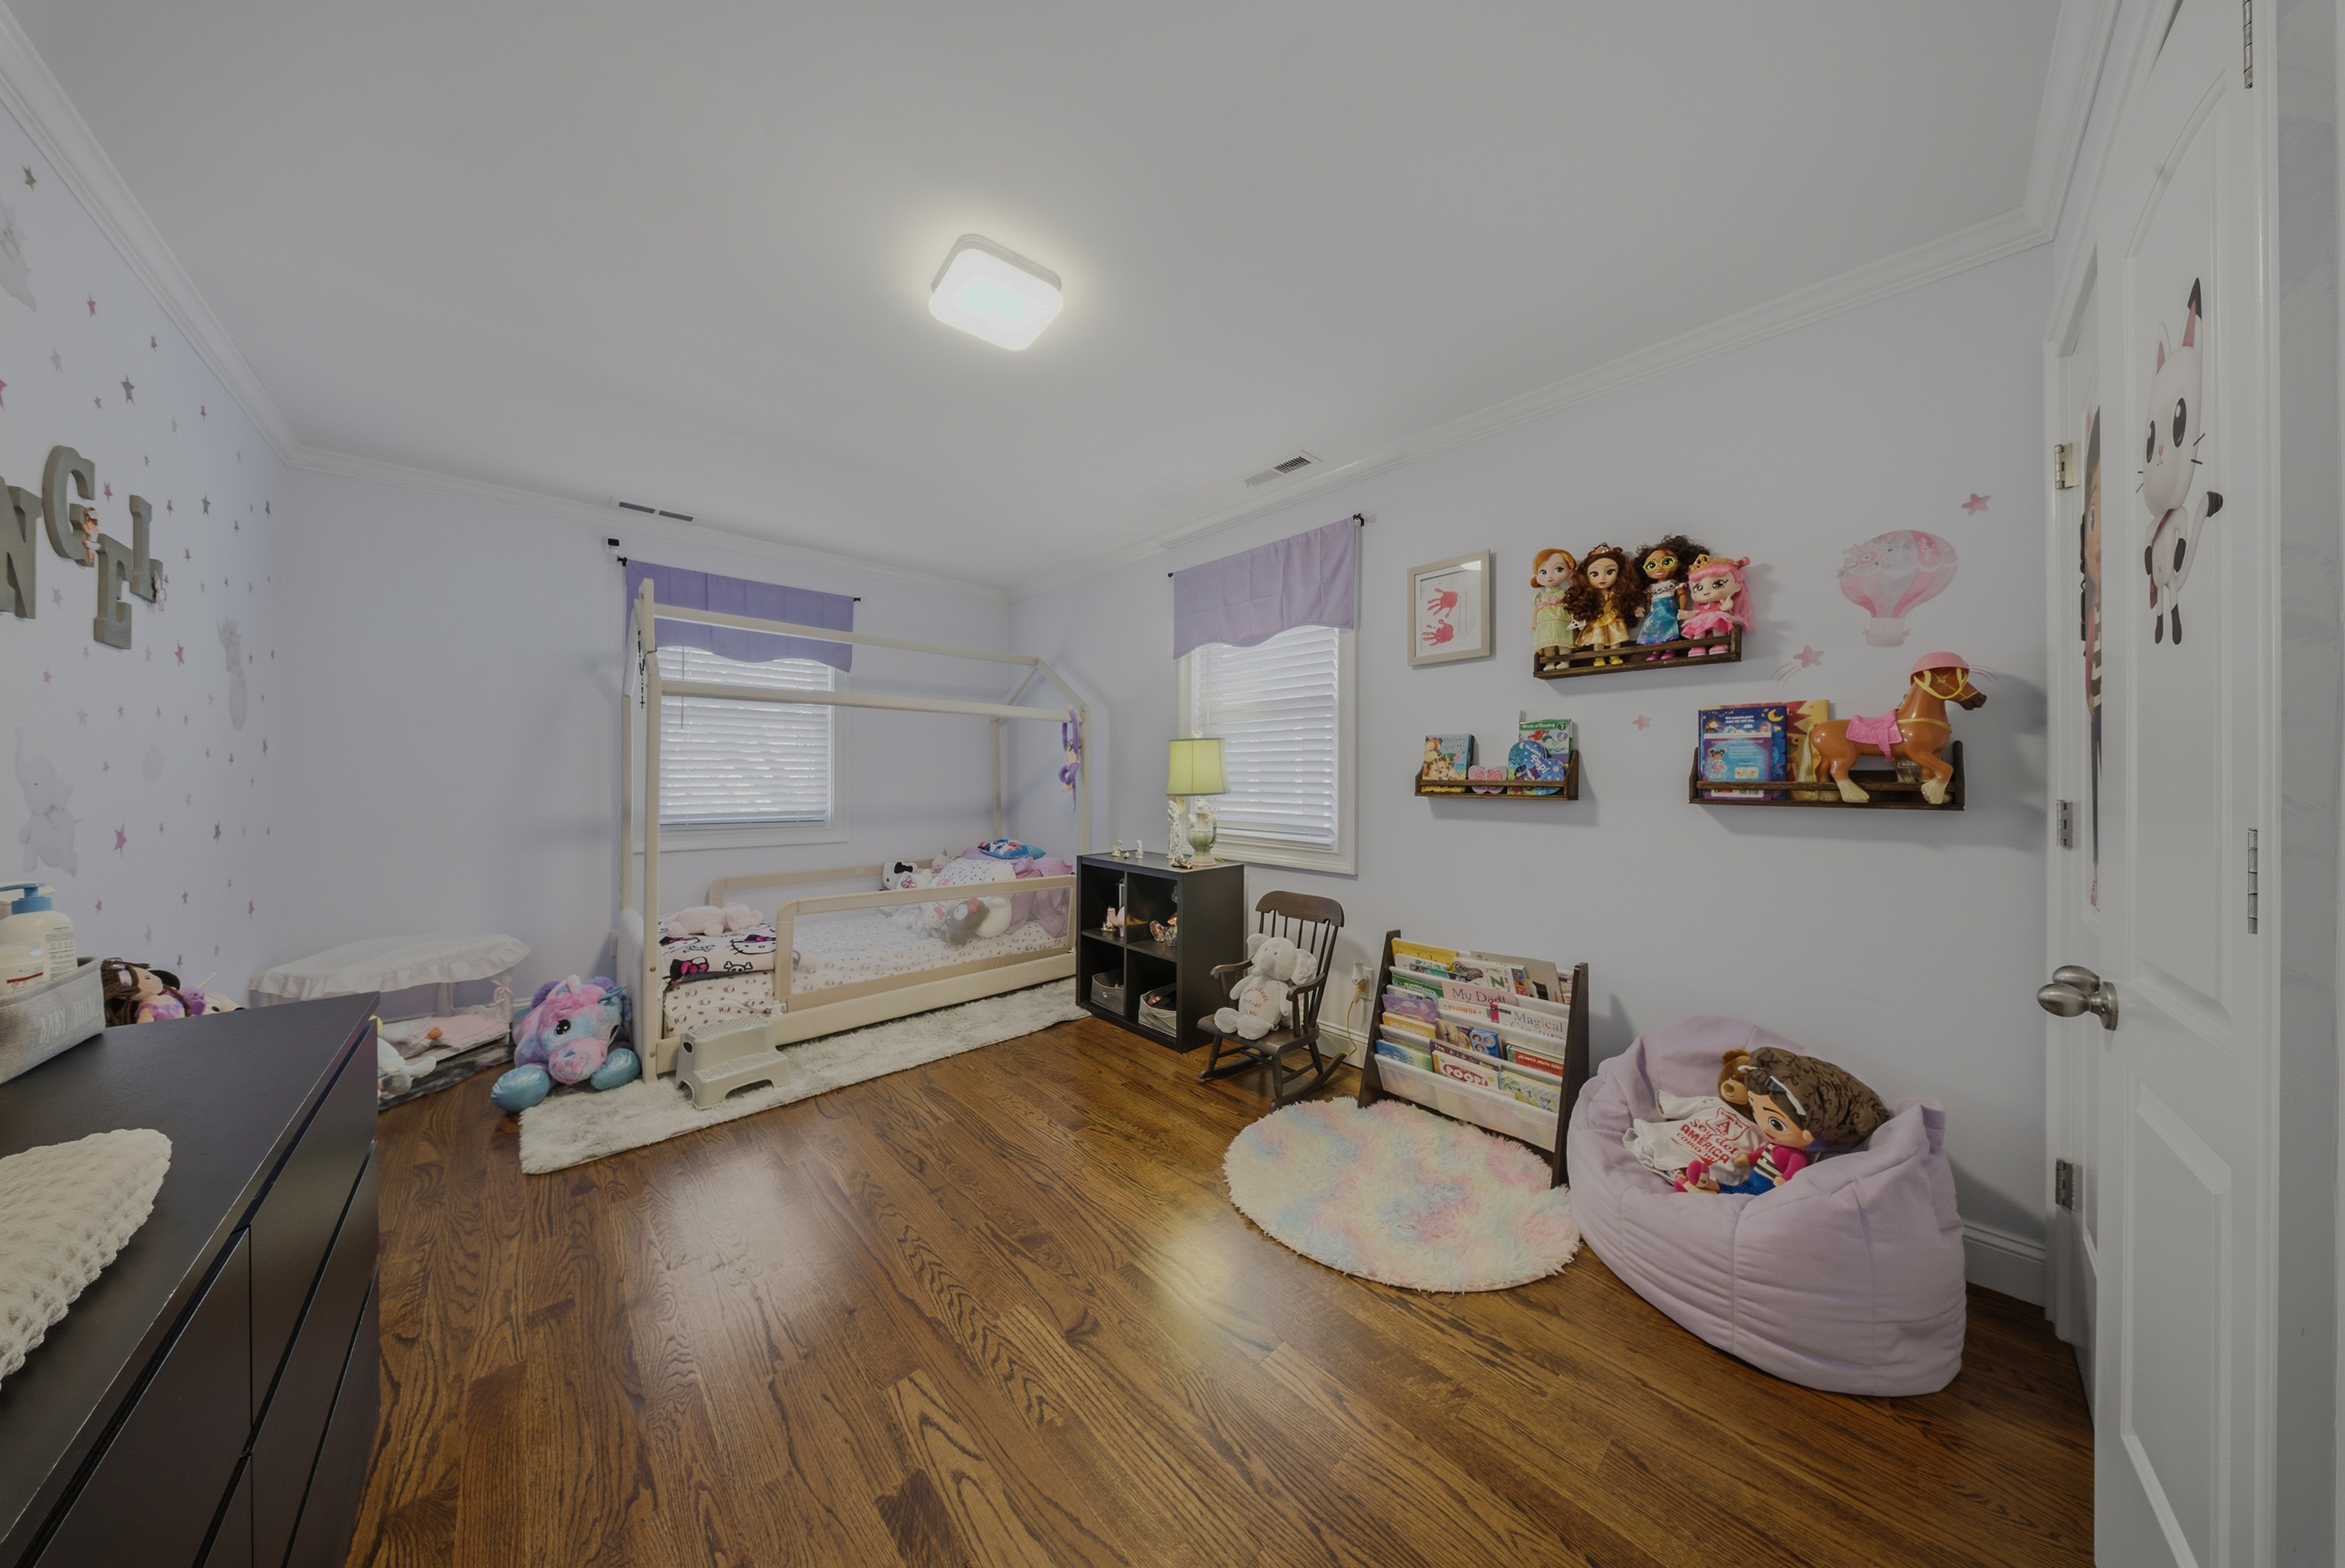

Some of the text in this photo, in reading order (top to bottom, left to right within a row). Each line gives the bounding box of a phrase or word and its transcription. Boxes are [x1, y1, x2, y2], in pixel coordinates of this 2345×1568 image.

[1452, 988, 1472, 1002] My
[1514, 1011, 1563, 1033] Magical
[1445, 1065, 1486, 1086] POOP!
